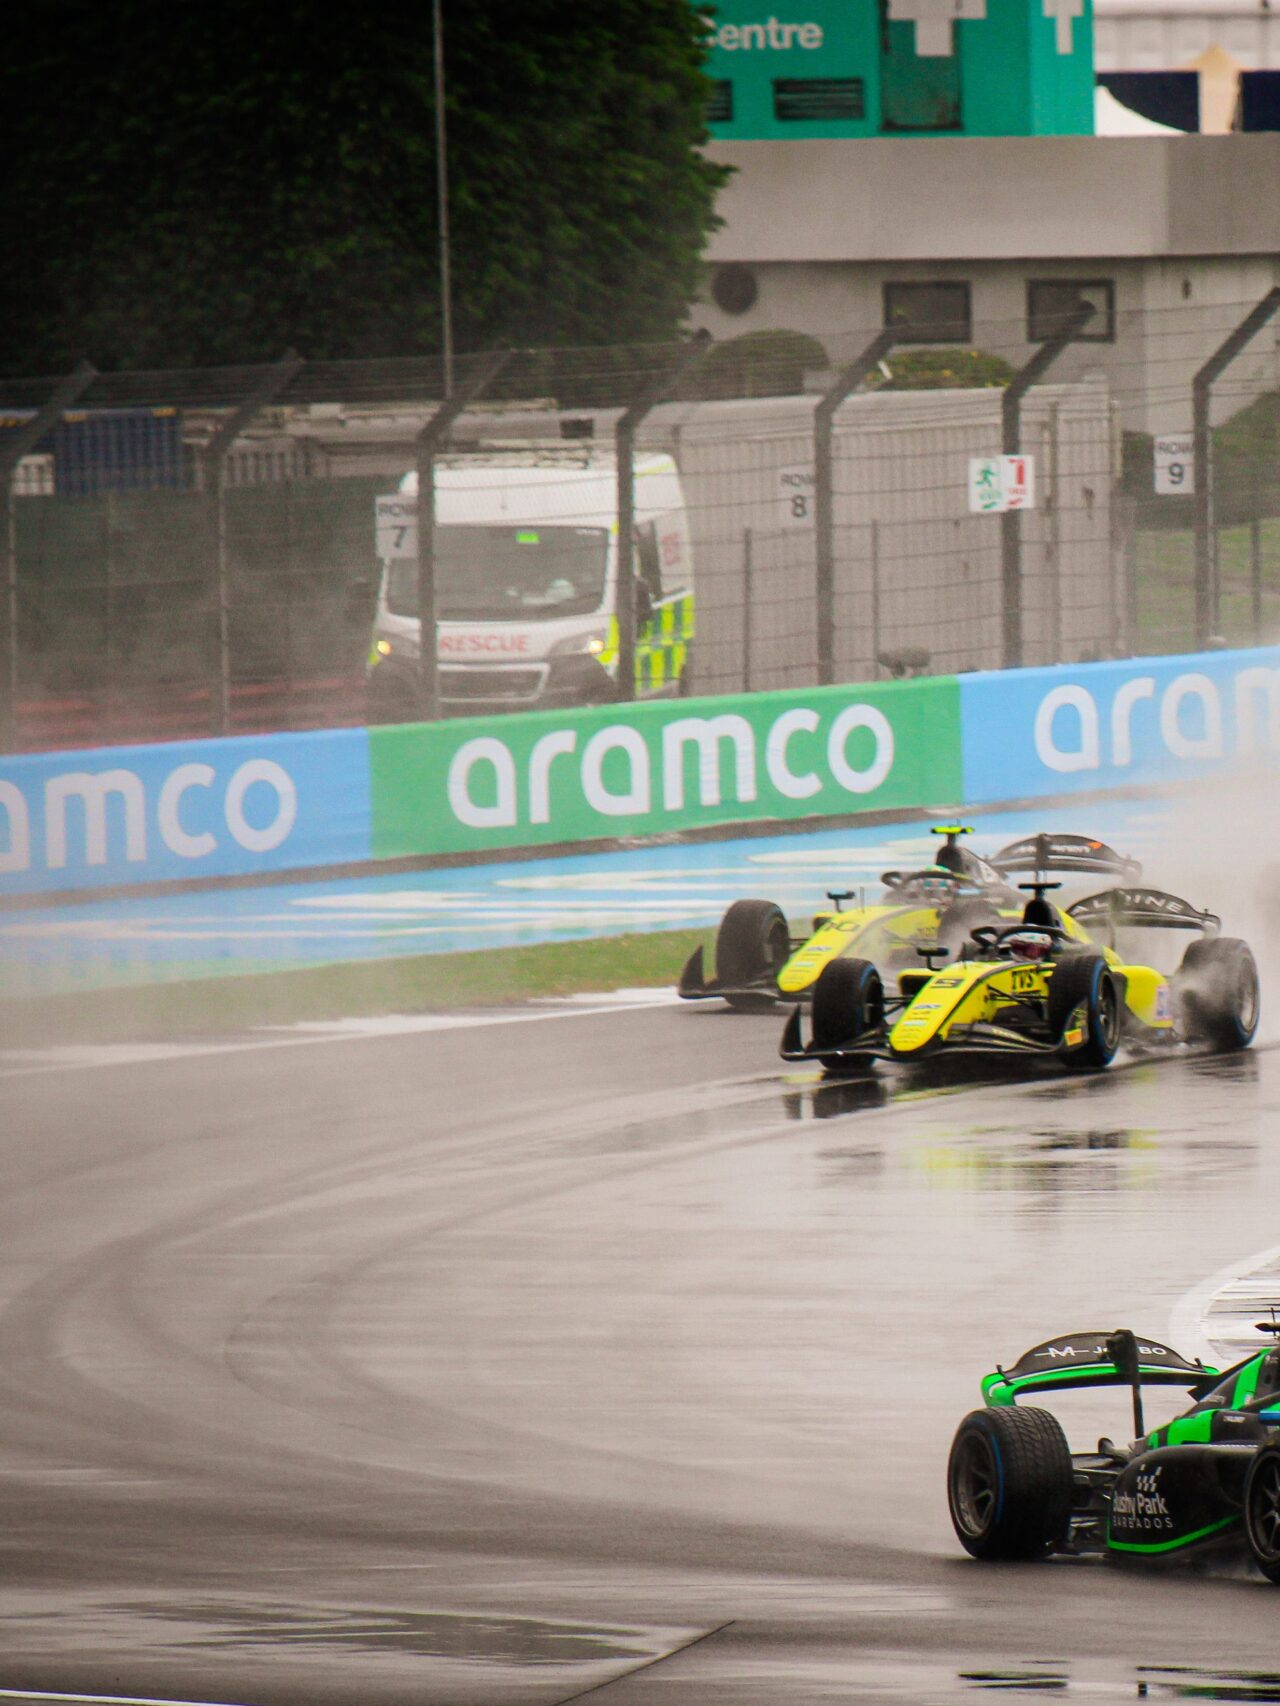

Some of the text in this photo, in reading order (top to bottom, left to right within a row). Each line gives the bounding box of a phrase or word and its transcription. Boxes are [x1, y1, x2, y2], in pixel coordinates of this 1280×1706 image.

[1169, 462, 1184, 485] 9
[791, 495, 807, 518] 8
[391, 525, 406, 548] 7
[440, 634, 528, 653] RESCUE
[447, 703, 895, 828] aramco
[0, 758, 297, 873] mco
[1011, 969, 1036, 990] TVS
[1092, 1345, 1167, 1355] JBO
[1136, 1492, 1169, 1515] Park
